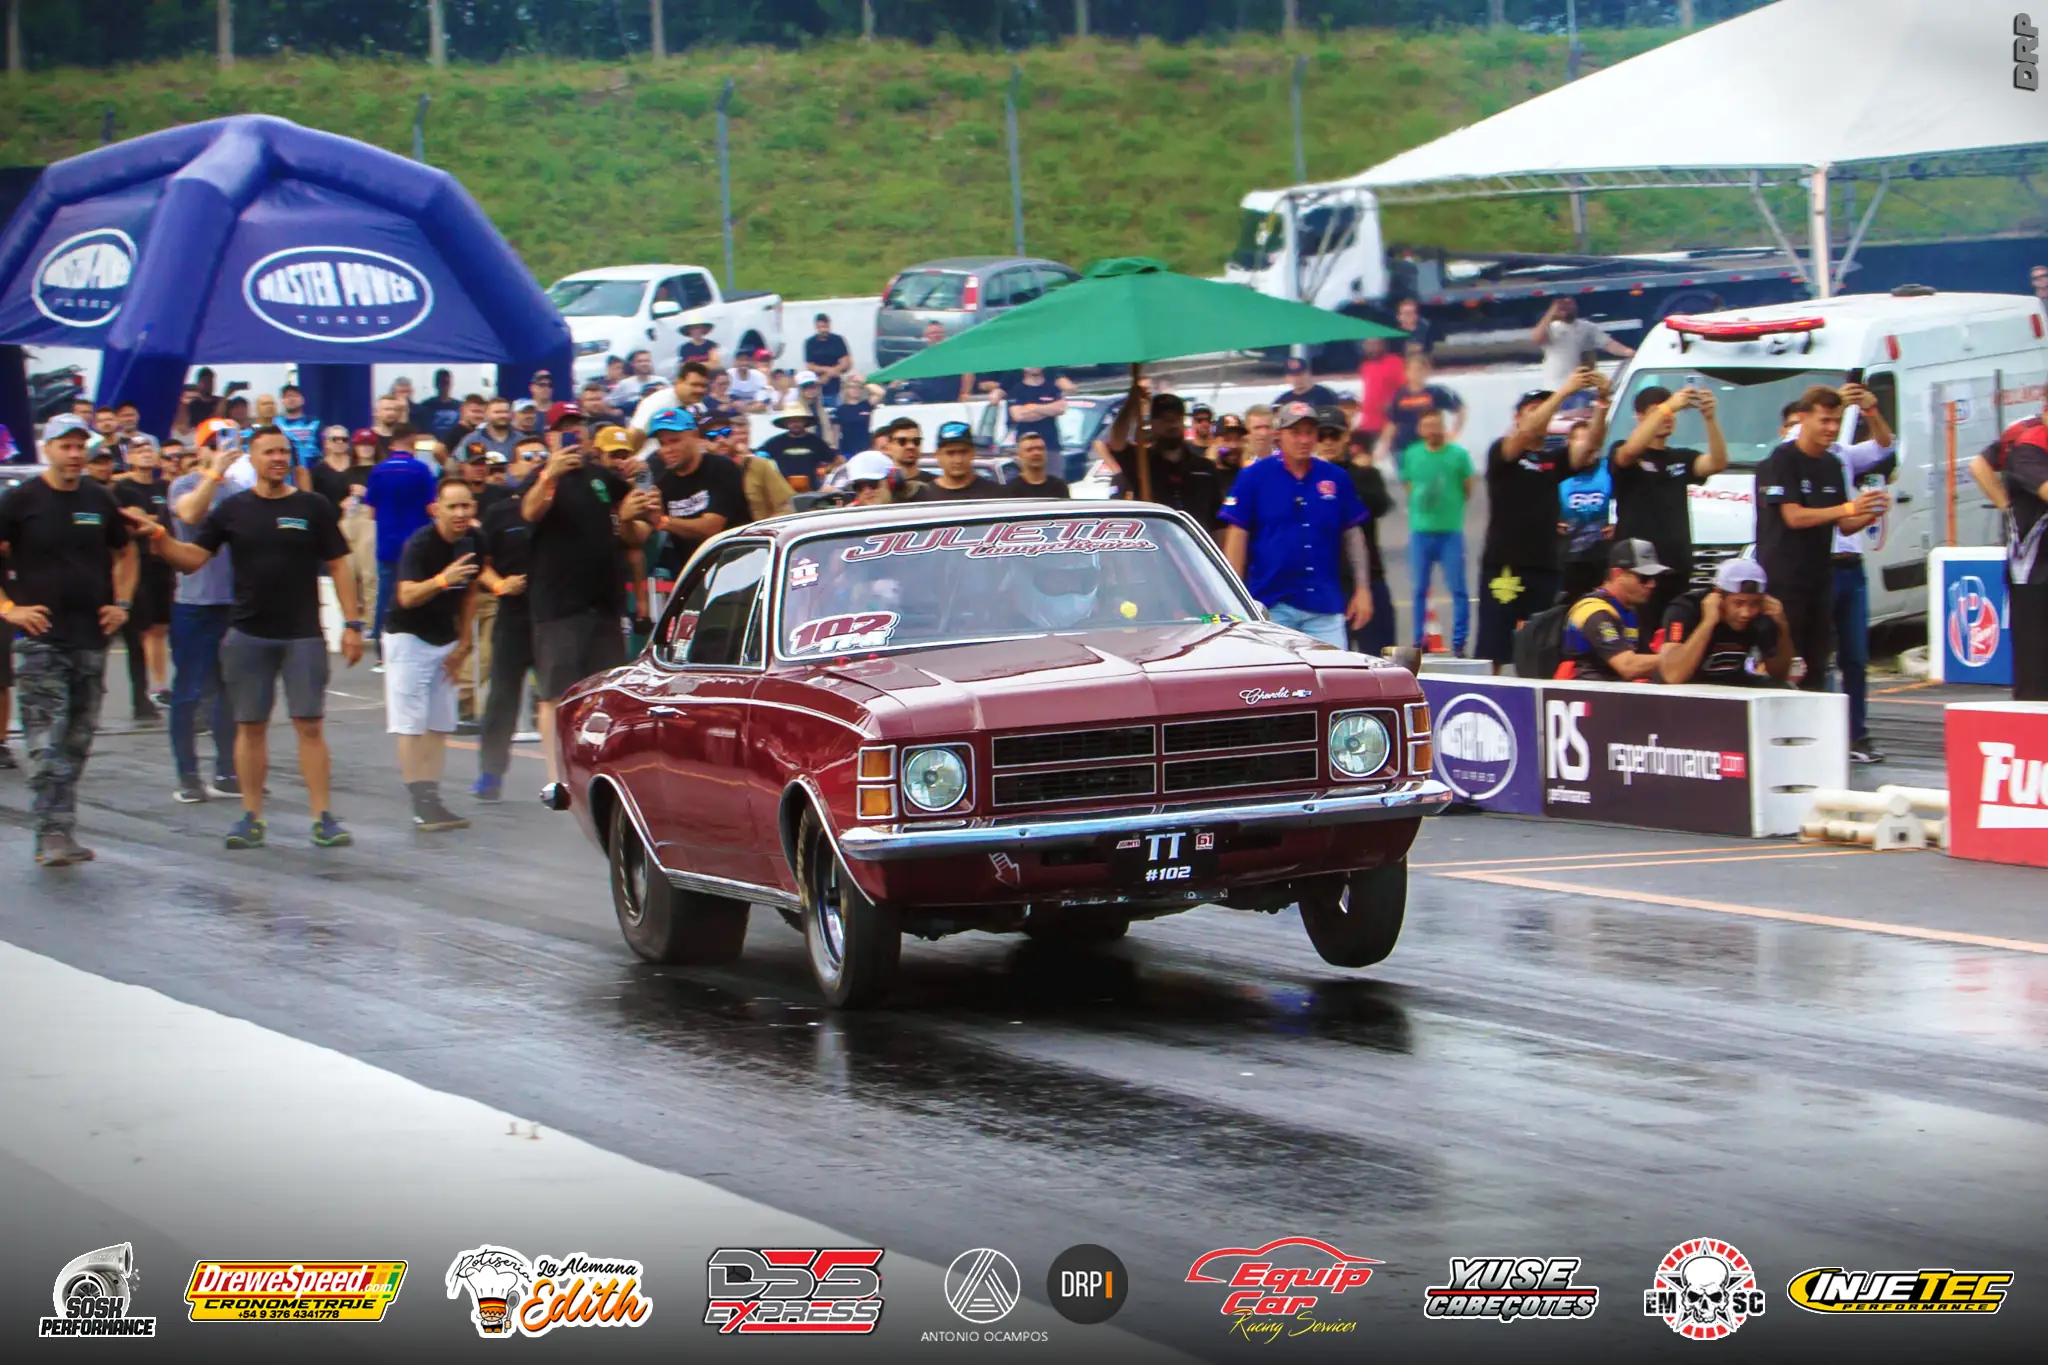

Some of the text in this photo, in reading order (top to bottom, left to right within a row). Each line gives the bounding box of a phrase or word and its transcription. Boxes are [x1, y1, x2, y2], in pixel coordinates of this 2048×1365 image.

[257, 261, 418, 306] MASTER POWER
[842, 518, 1147, 561] JULIETA
[790, 611, 899, 655] 102
[1545, 700, 1592, 781] RS
[1977, 741, 2048, 806] Fu
[1145, 832, 1187, 861] TT
[1145, 865, 1192, 882] #102
